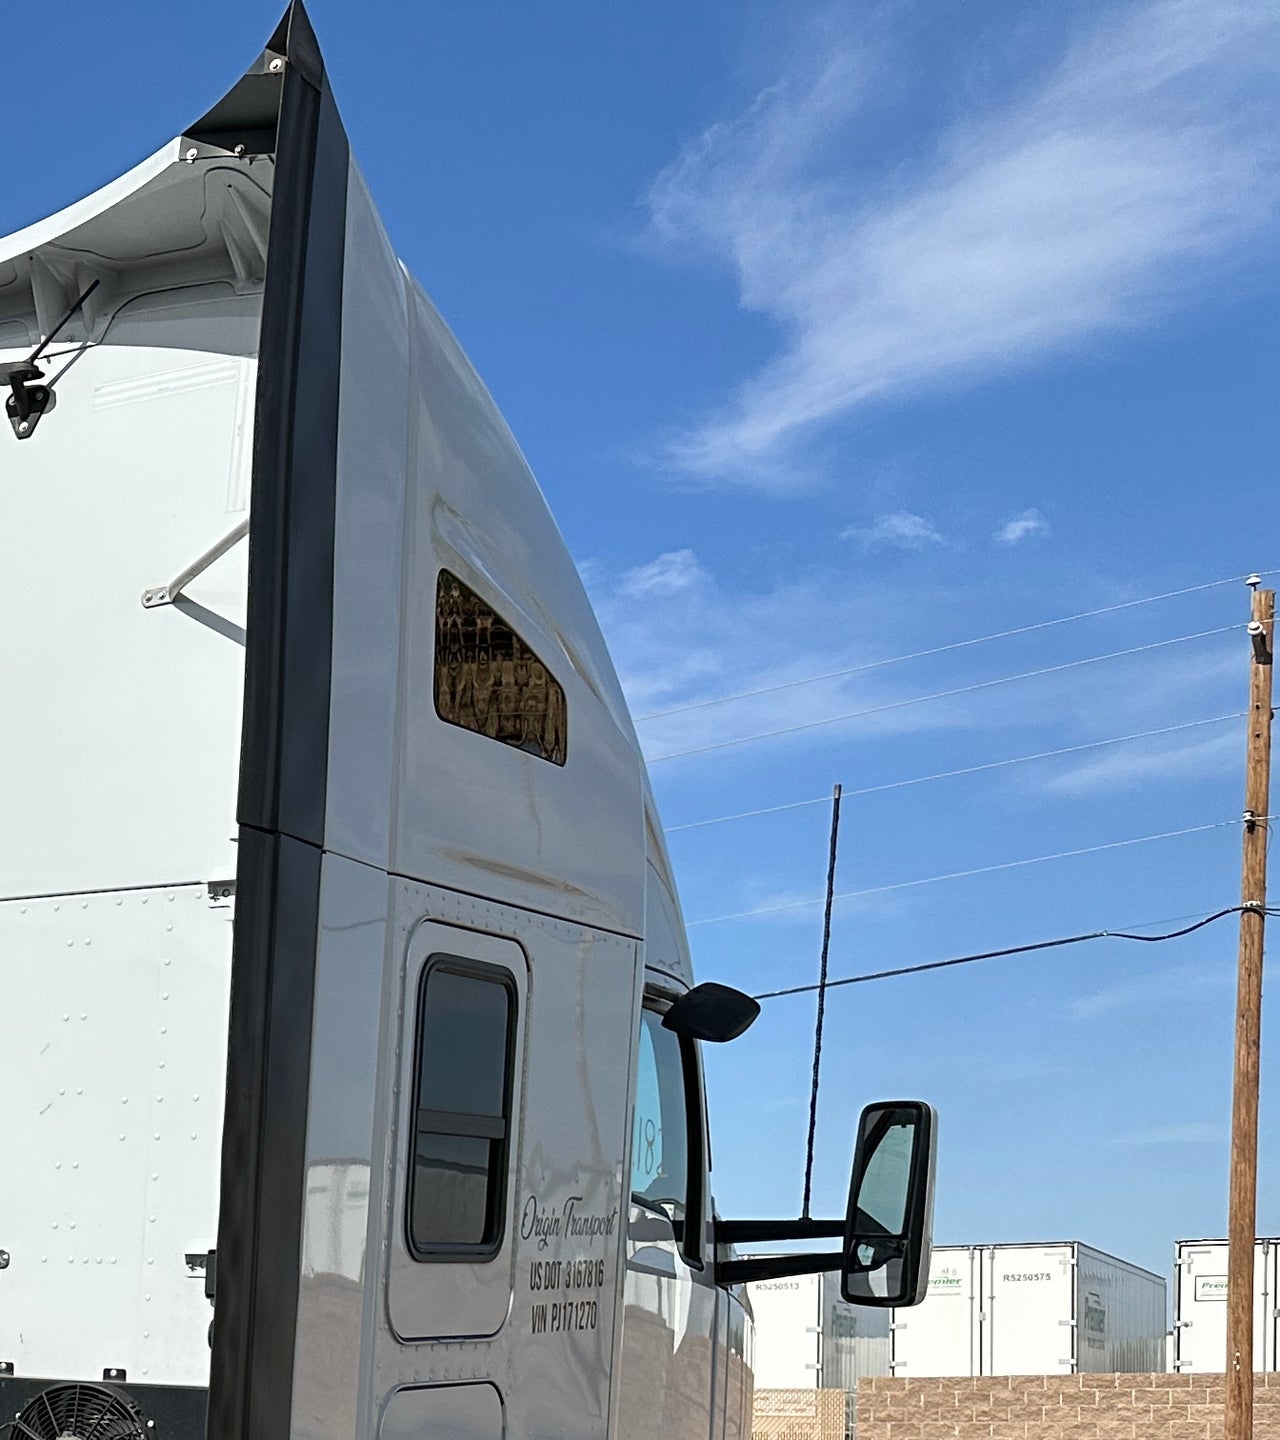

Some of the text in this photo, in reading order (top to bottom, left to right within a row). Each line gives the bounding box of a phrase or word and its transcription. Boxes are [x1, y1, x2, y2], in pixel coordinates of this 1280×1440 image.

[521, 1194, 618, 1251] Origin Transport
[530, 1259, 605, 1291] US DOT 3167816
[1002, 1272, 1052, 1282] R5250575
[531, 1301, 598, 1334] VIN PJ171270
